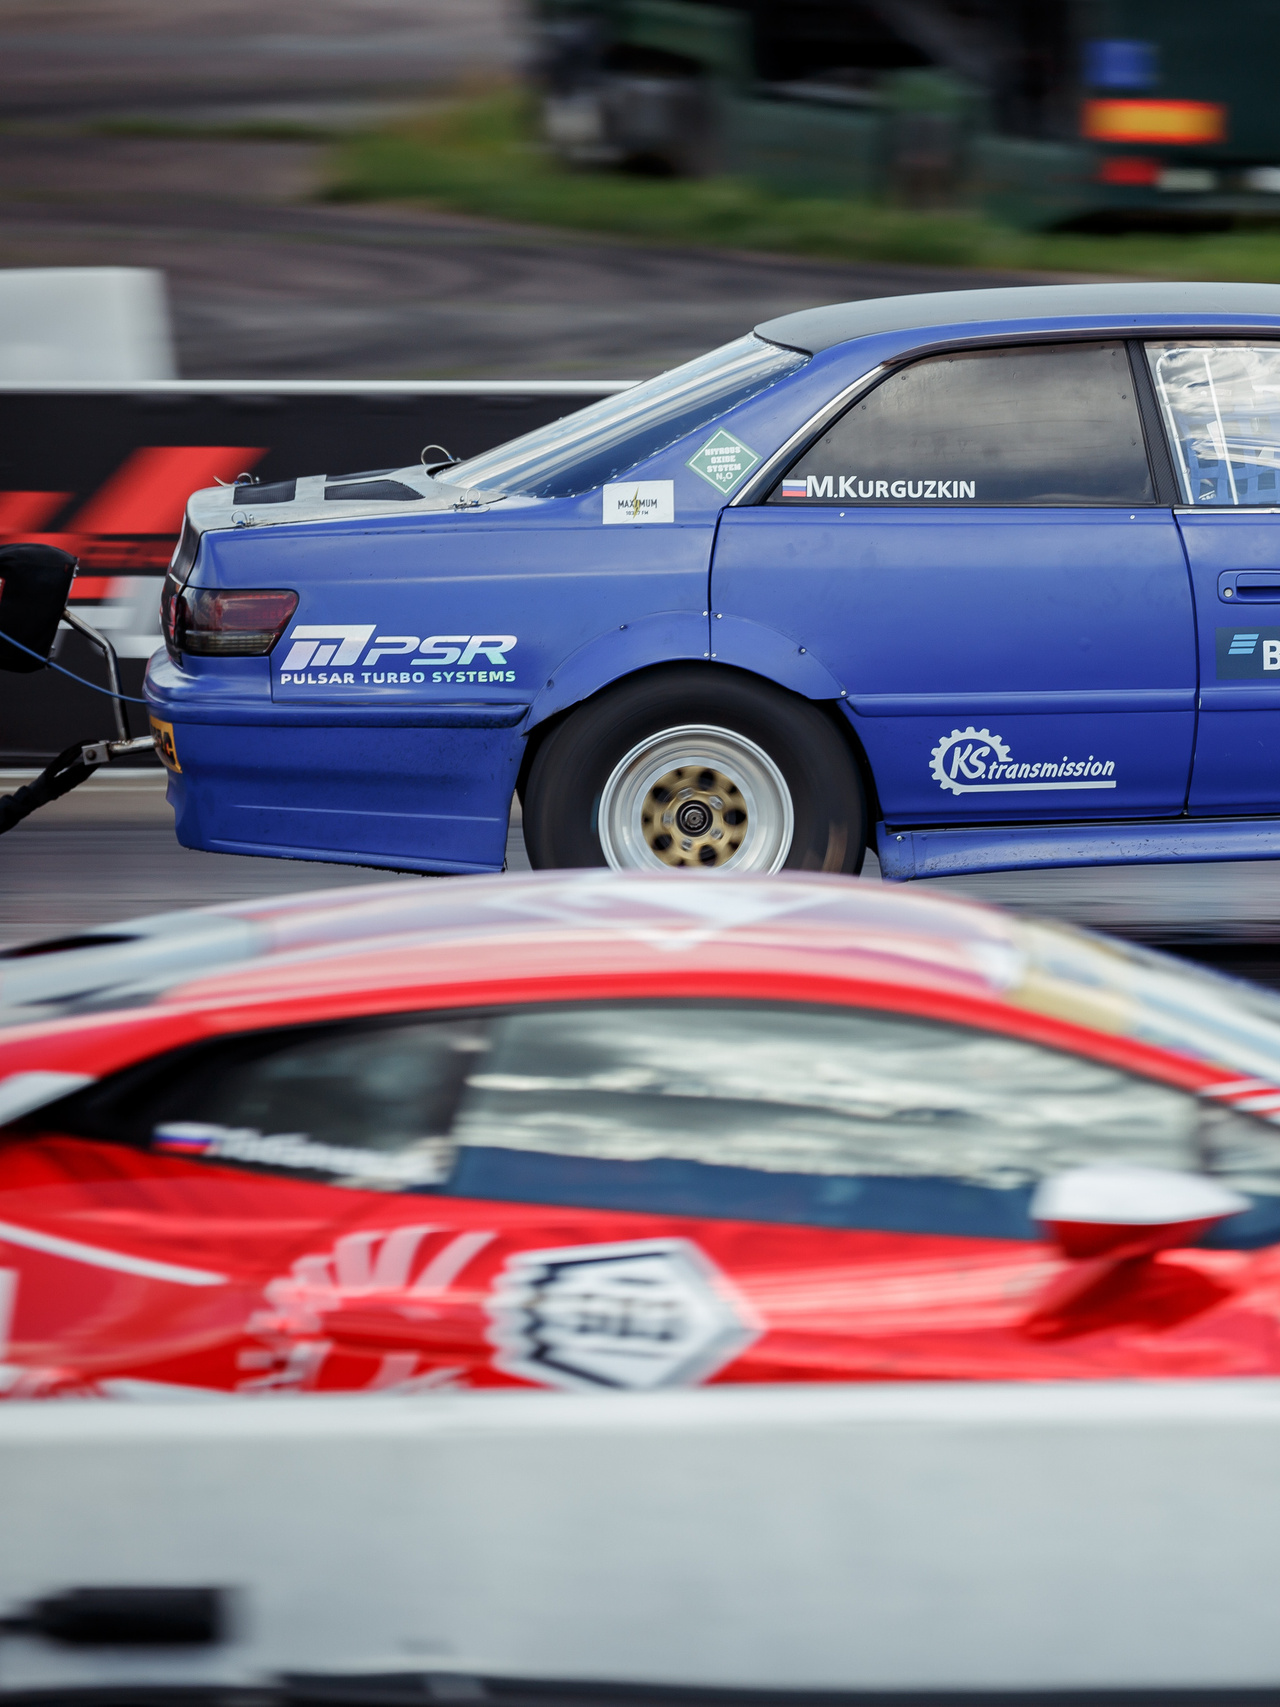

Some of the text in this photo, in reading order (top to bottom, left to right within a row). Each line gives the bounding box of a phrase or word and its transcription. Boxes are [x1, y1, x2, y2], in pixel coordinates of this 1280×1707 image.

[704, 446, 741, 456] NITROUS
[710, 455, 736, 464] OXIDE
[706, 463, 742, 473] SYSTEM
[281, 670, 516, 685] PULSAR TURBO SYSTEMS
